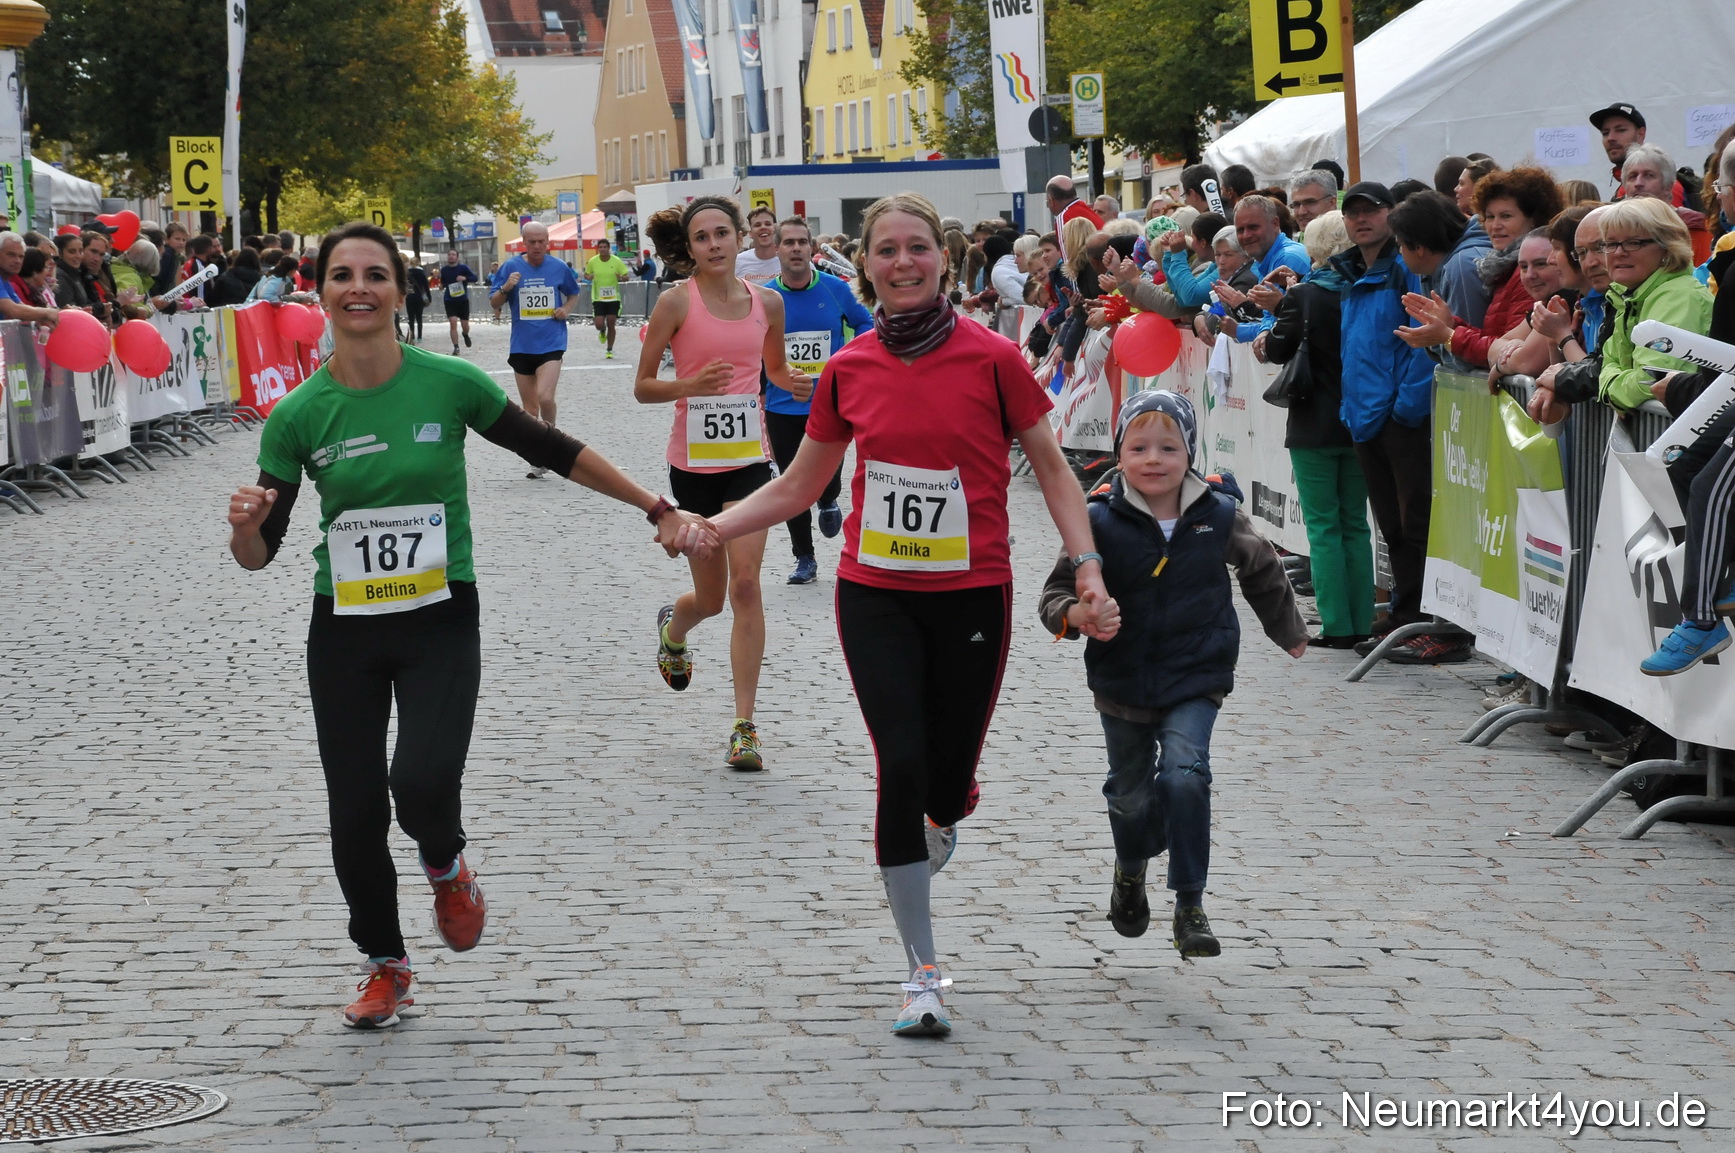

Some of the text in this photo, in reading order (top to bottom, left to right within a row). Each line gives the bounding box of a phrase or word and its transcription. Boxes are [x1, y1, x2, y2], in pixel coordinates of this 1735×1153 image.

[1276, 0, 1328, 64] B
[837, 75, 855, 96] HOTEL
[176, 140, 215, 153] Block
[184, 159, 209, 195] C
[751, 190, 772, 198] Block
[367, 200, 388, 208] Block
[372, 210, 385, 228] D
[526, 295, 549, 308] 320
[790, 343, 821, 360] 326
[689, 401, 748, 411] PARTL Neumarkt
[704, 412, 747, 440] 531
[867, 470, 949, 492] PARTL Neumarkt
[883, 491, 947, 533] 167
[330, 516, 425, 533] PARTL Neumarkt
[354, 532, 423, 574] 187
[890, 540, 930, 558] Anika
[366, 582, 417, 600] Bettina
